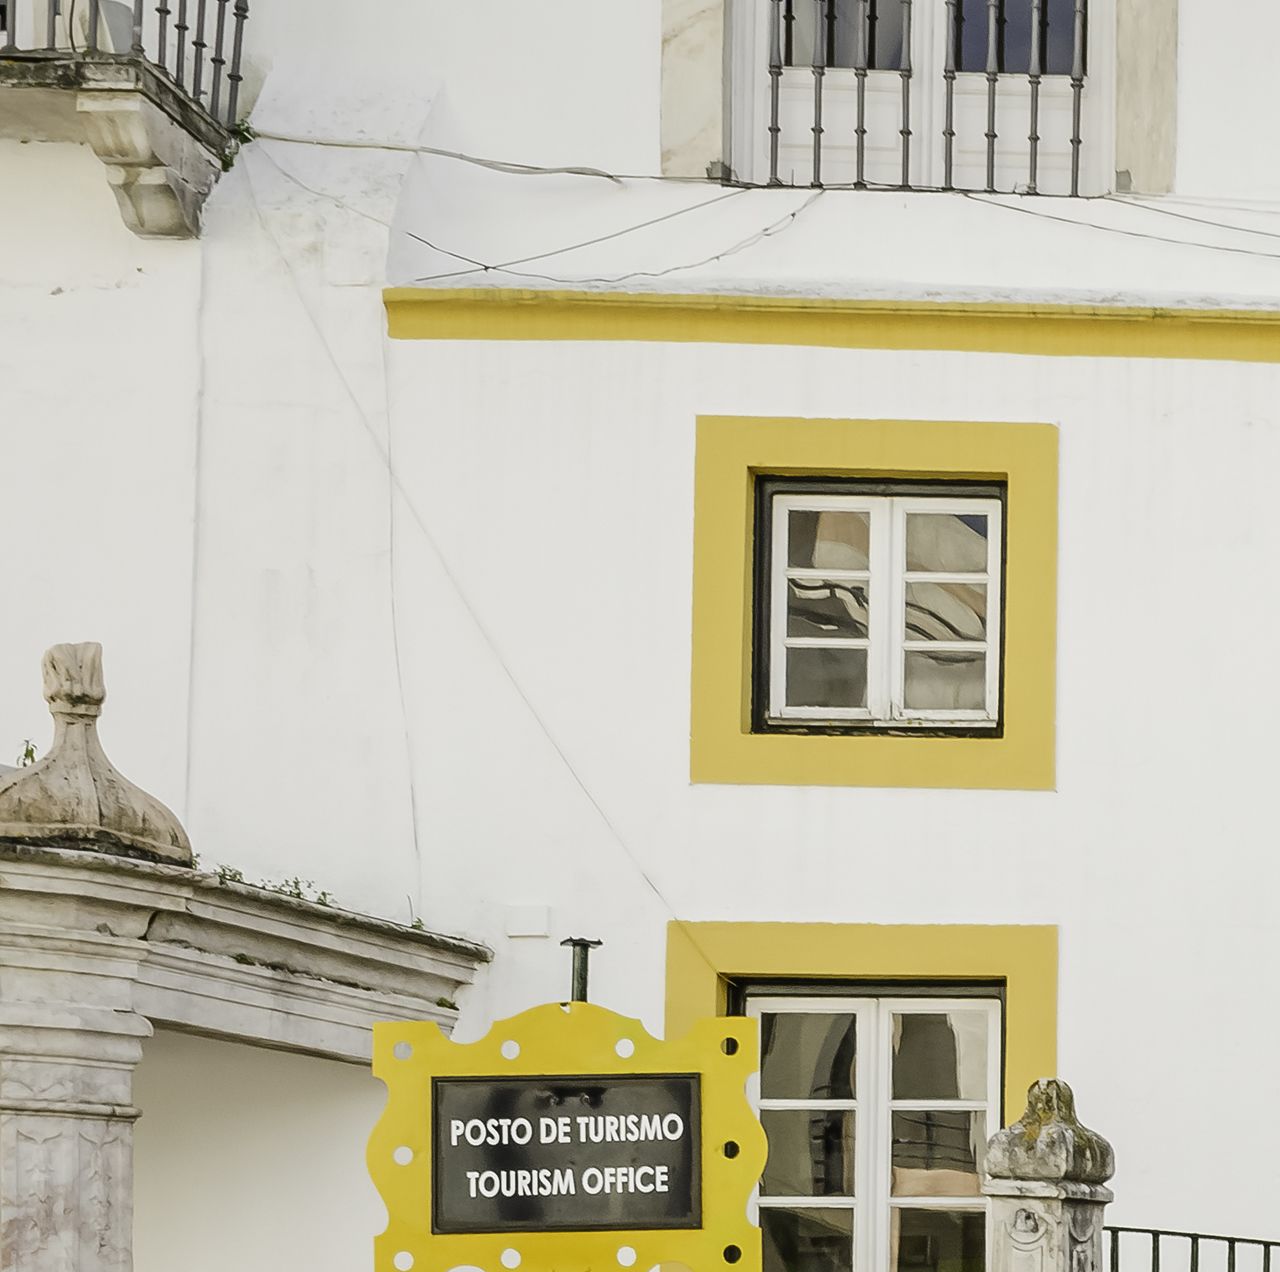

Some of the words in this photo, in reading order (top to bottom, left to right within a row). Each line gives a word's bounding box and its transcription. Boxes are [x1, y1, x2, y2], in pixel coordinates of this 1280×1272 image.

[450, 1118, 533, 1146] POSTO
[539, 1116, 572, 1144] DE
[576, 1112, 685, 1143] TURISMO
[465, 1168, 577, 1198] TOURISM
[581, 1165, 670, 1195] OFFICE
